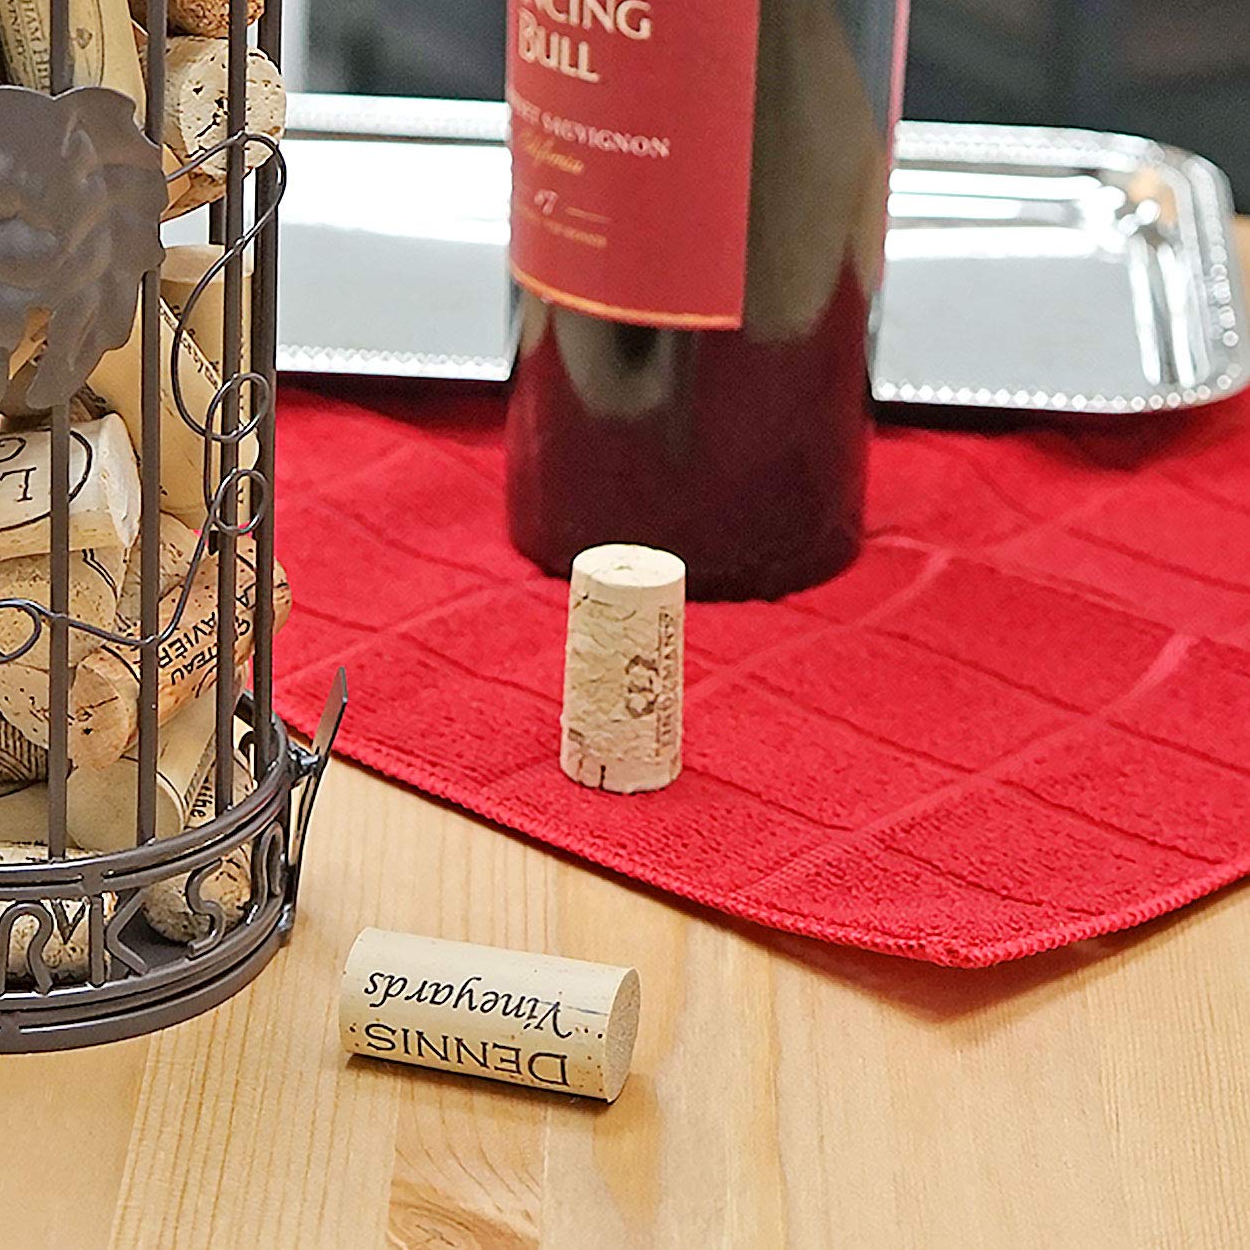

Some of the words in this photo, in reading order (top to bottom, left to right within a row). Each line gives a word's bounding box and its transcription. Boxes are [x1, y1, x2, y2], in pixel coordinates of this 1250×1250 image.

[518, 6, 600, 84] BULL
[363, 971, 573, 1039] Vineyards
[364, 1022, 572, 1088] DENNIS
